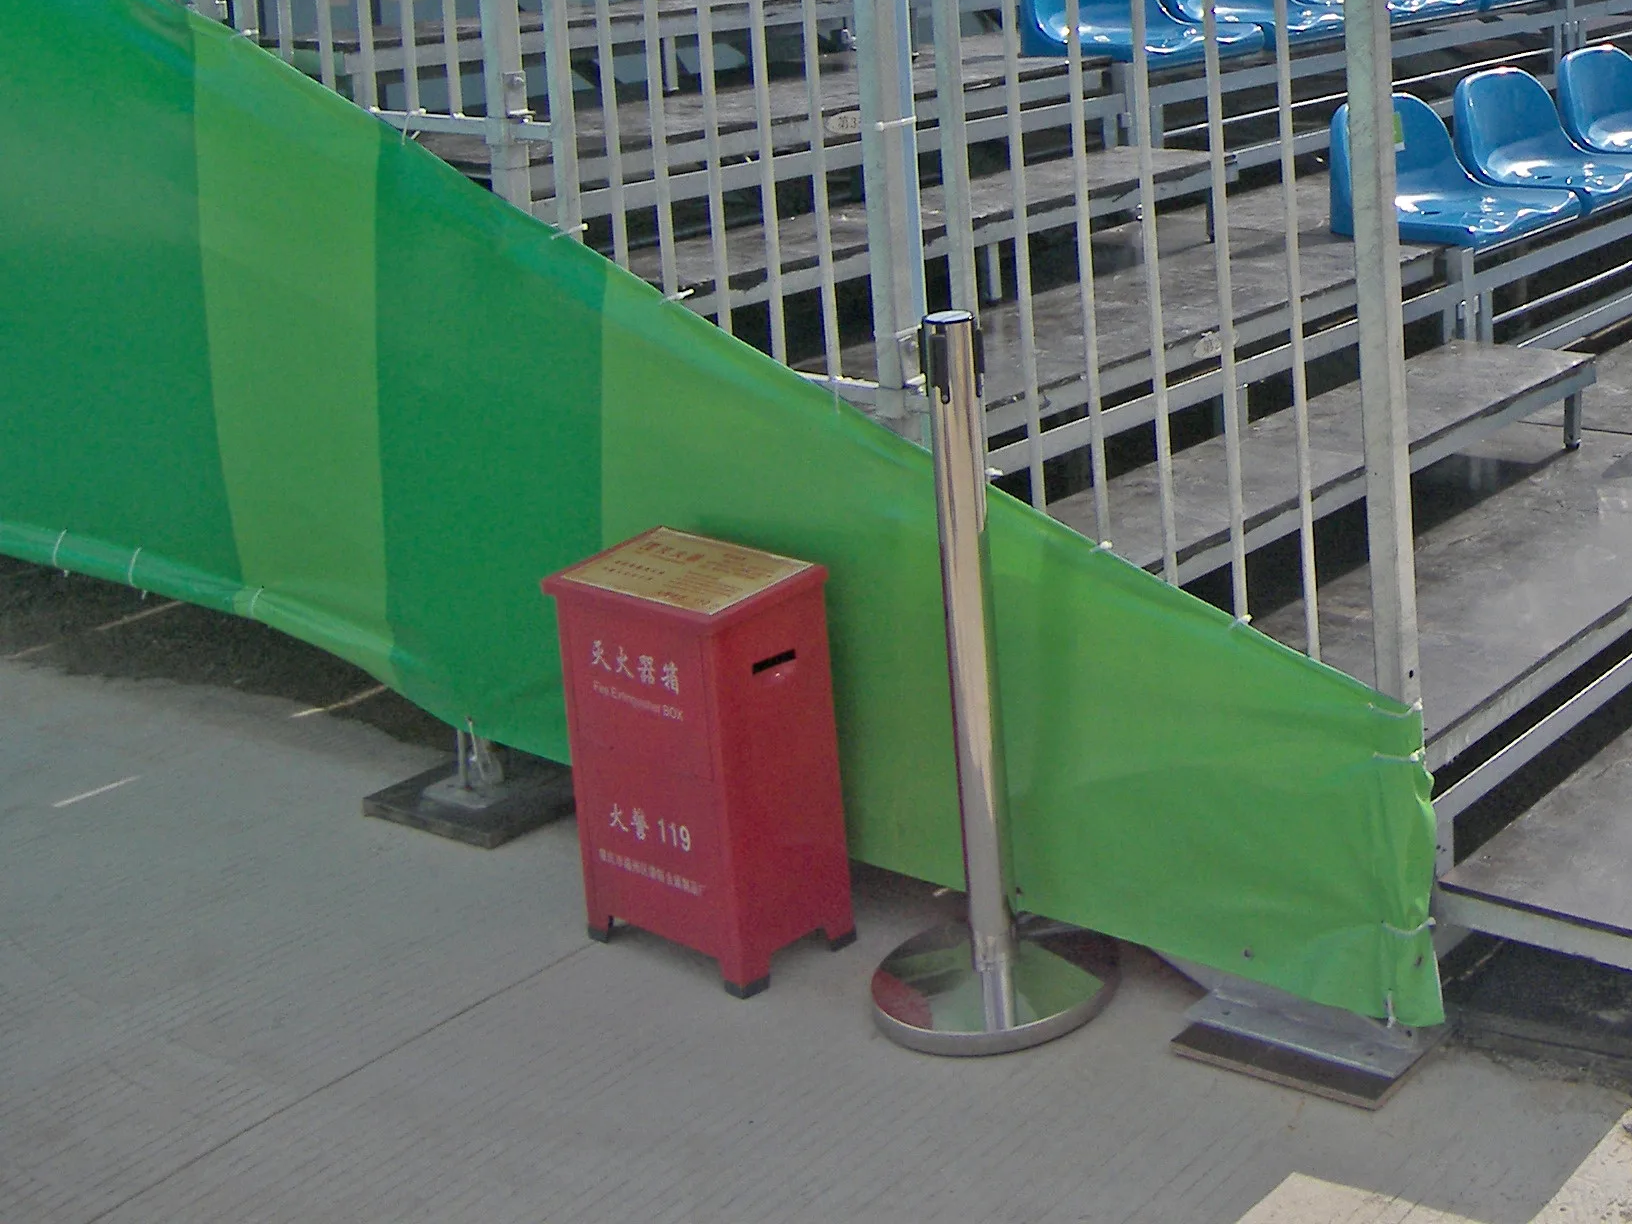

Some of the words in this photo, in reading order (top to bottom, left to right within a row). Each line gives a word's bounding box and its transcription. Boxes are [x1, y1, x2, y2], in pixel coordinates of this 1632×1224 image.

[591, 638, 680, 696] 灭火器箱
[661, 703, 685, 722] BOX
[608, 802, 650, 842] 火警
[657, 817, 692, 853] 119
